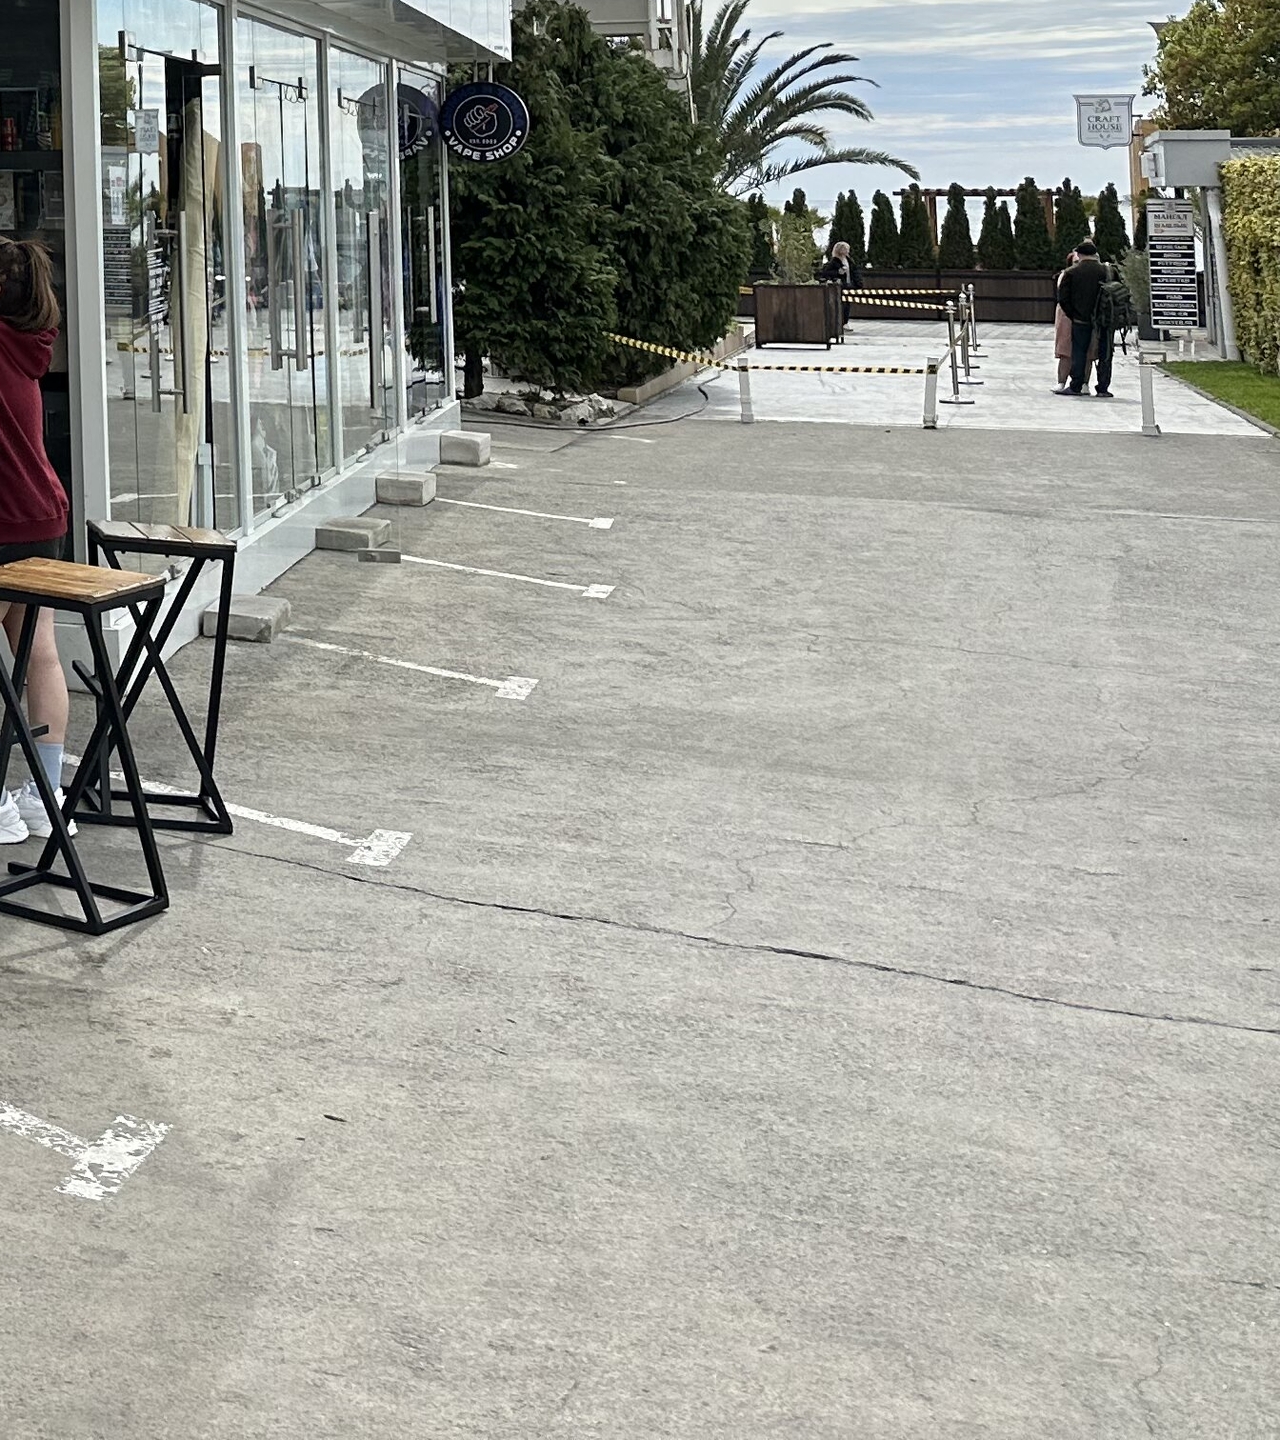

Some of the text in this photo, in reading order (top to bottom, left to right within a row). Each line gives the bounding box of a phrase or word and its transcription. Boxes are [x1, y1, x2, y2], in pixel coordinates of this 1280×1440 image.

[1087, 115, 1121, 123] CRAFT
[1087, 123, 1122, 131] HOUSE
[448, 136, 518, 161] VAPE SHOP
